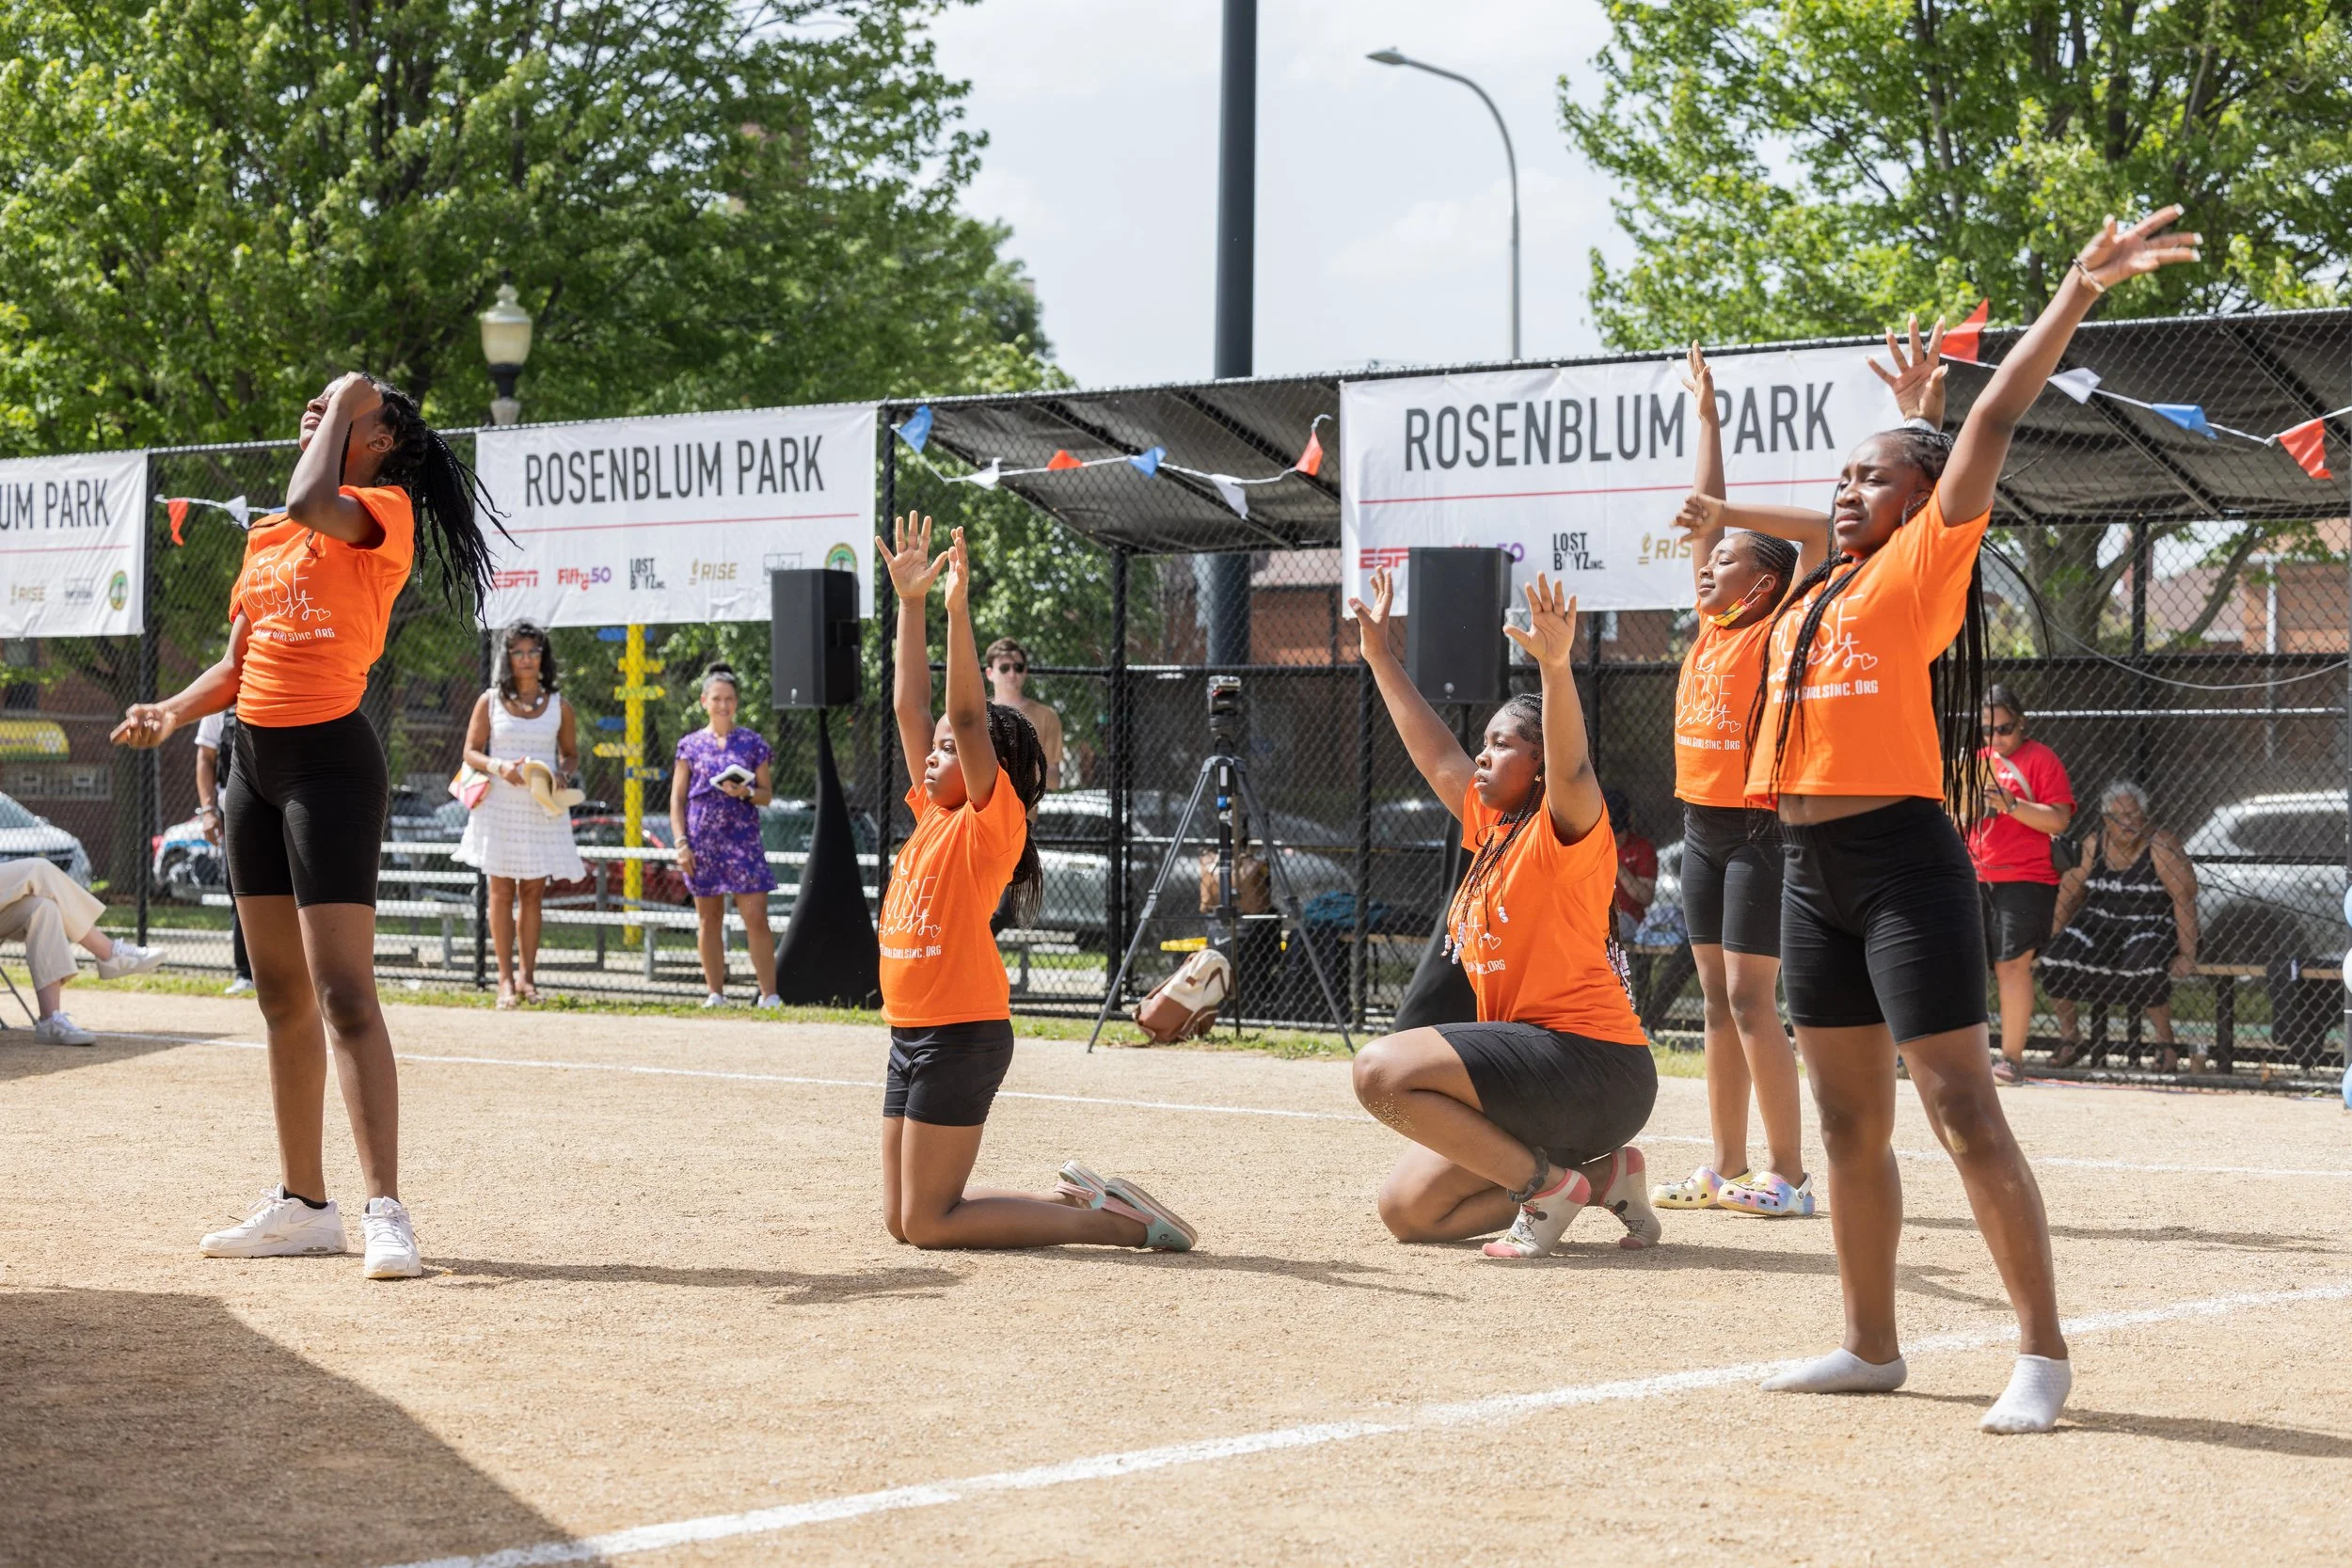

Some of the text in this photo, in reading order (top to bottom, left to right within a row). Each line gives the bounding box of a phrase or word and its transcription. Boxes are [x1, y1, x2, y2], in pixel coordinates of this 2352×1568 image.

[1405, 391, 1686, 471] ROSENBLUM
[526, 435, 825, 507] ROSENBLUM PARK
[45, 479, 110, 529] PARK
[1553, 532, 1588, 552] LOST
[1655, 538, 1693, 560] RIS
[630, 558, 656, 575] LOST
[1359, 547, 1409, 569] ESP
[1553, 551, 1590, 571] BYZ
[492, 570, 539, 589] ESPN
[700, 562, 738, 580] RISE
